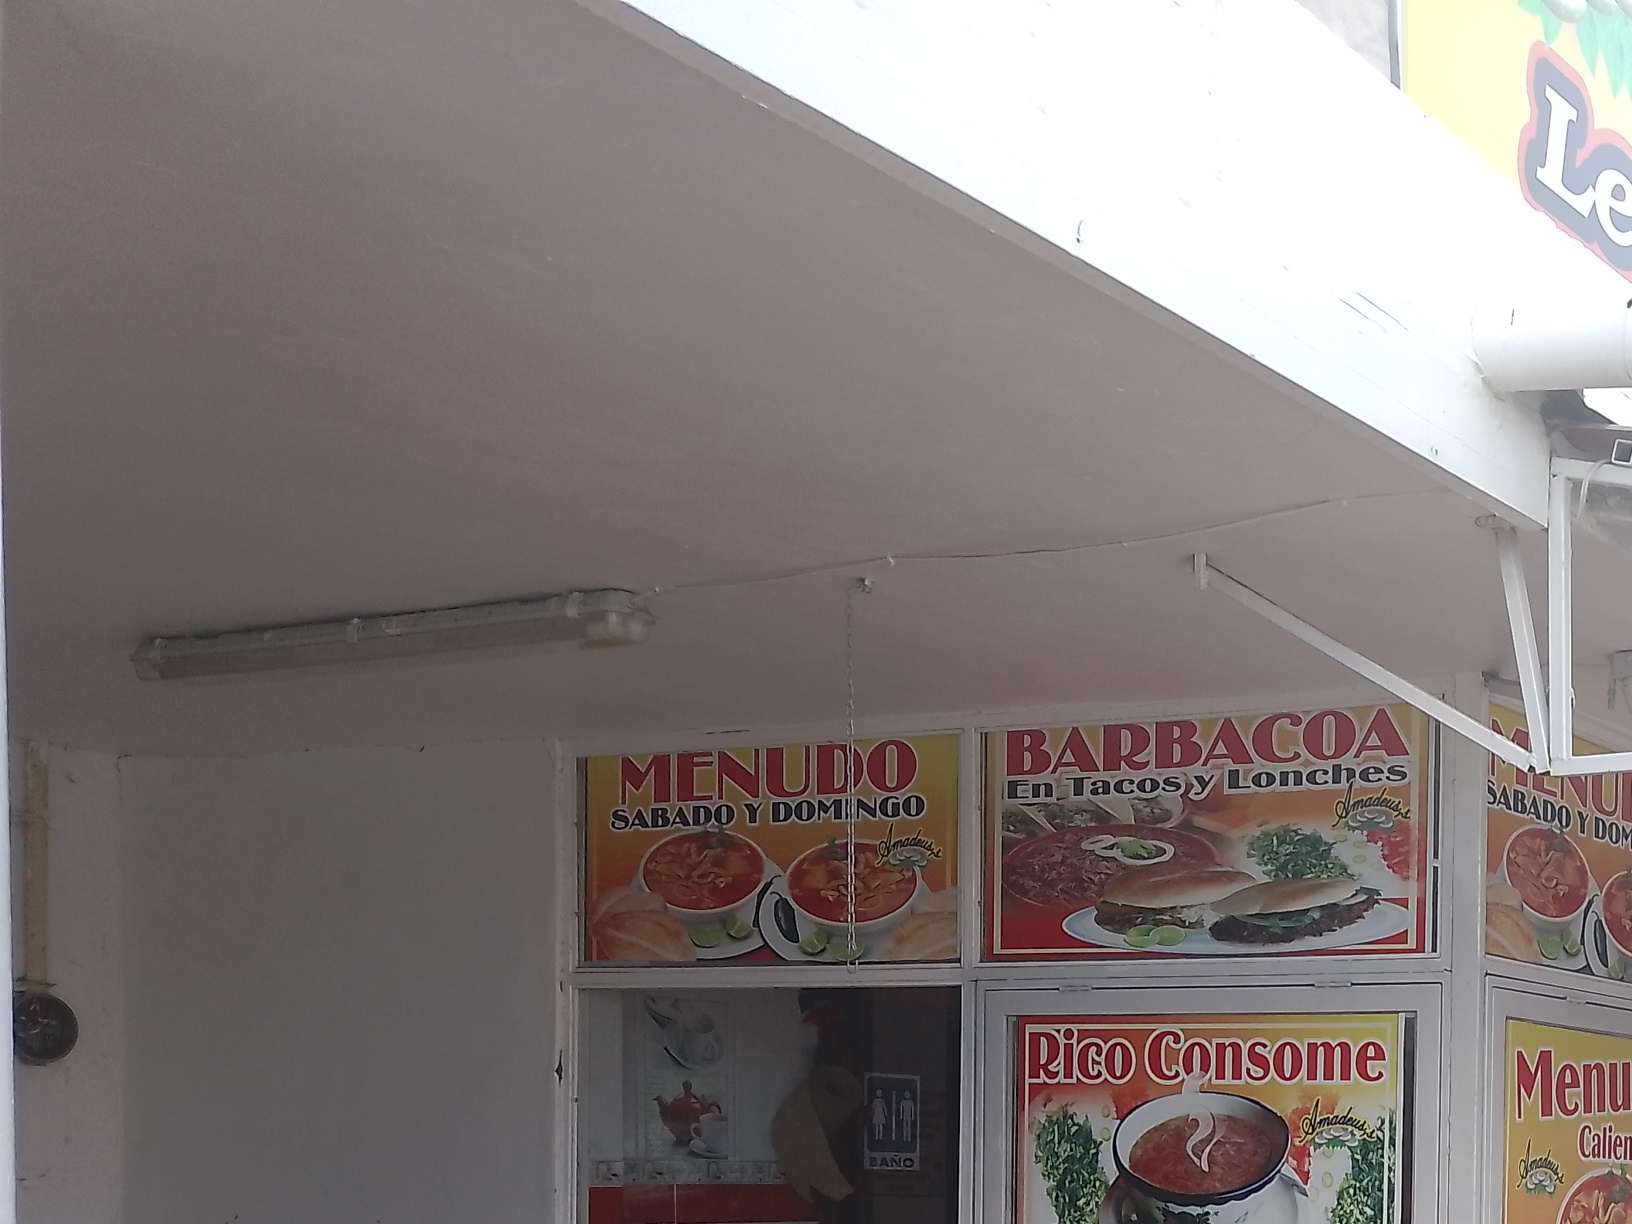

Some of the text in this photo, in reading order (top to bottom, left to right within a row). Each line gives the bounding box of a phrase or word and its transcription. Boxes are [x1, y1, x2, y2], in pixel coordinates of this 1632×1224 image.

[1006, 707, 1410, 776] BARBACOA
[619, 739, 918, 805] MENUDO
[1007, 762, 1409, 800] En Tacos y Lonches
[610, 803, 735, 831] SABADO
[743, 802, 761, 825] Y
[1487, 779, 1572, 830] SABADO
[1576, 810, 1590, 835] Y
[1027, 1027, 1388, 1084] Rico Consome
[868, 1153, 916, 1169] BAÑO
